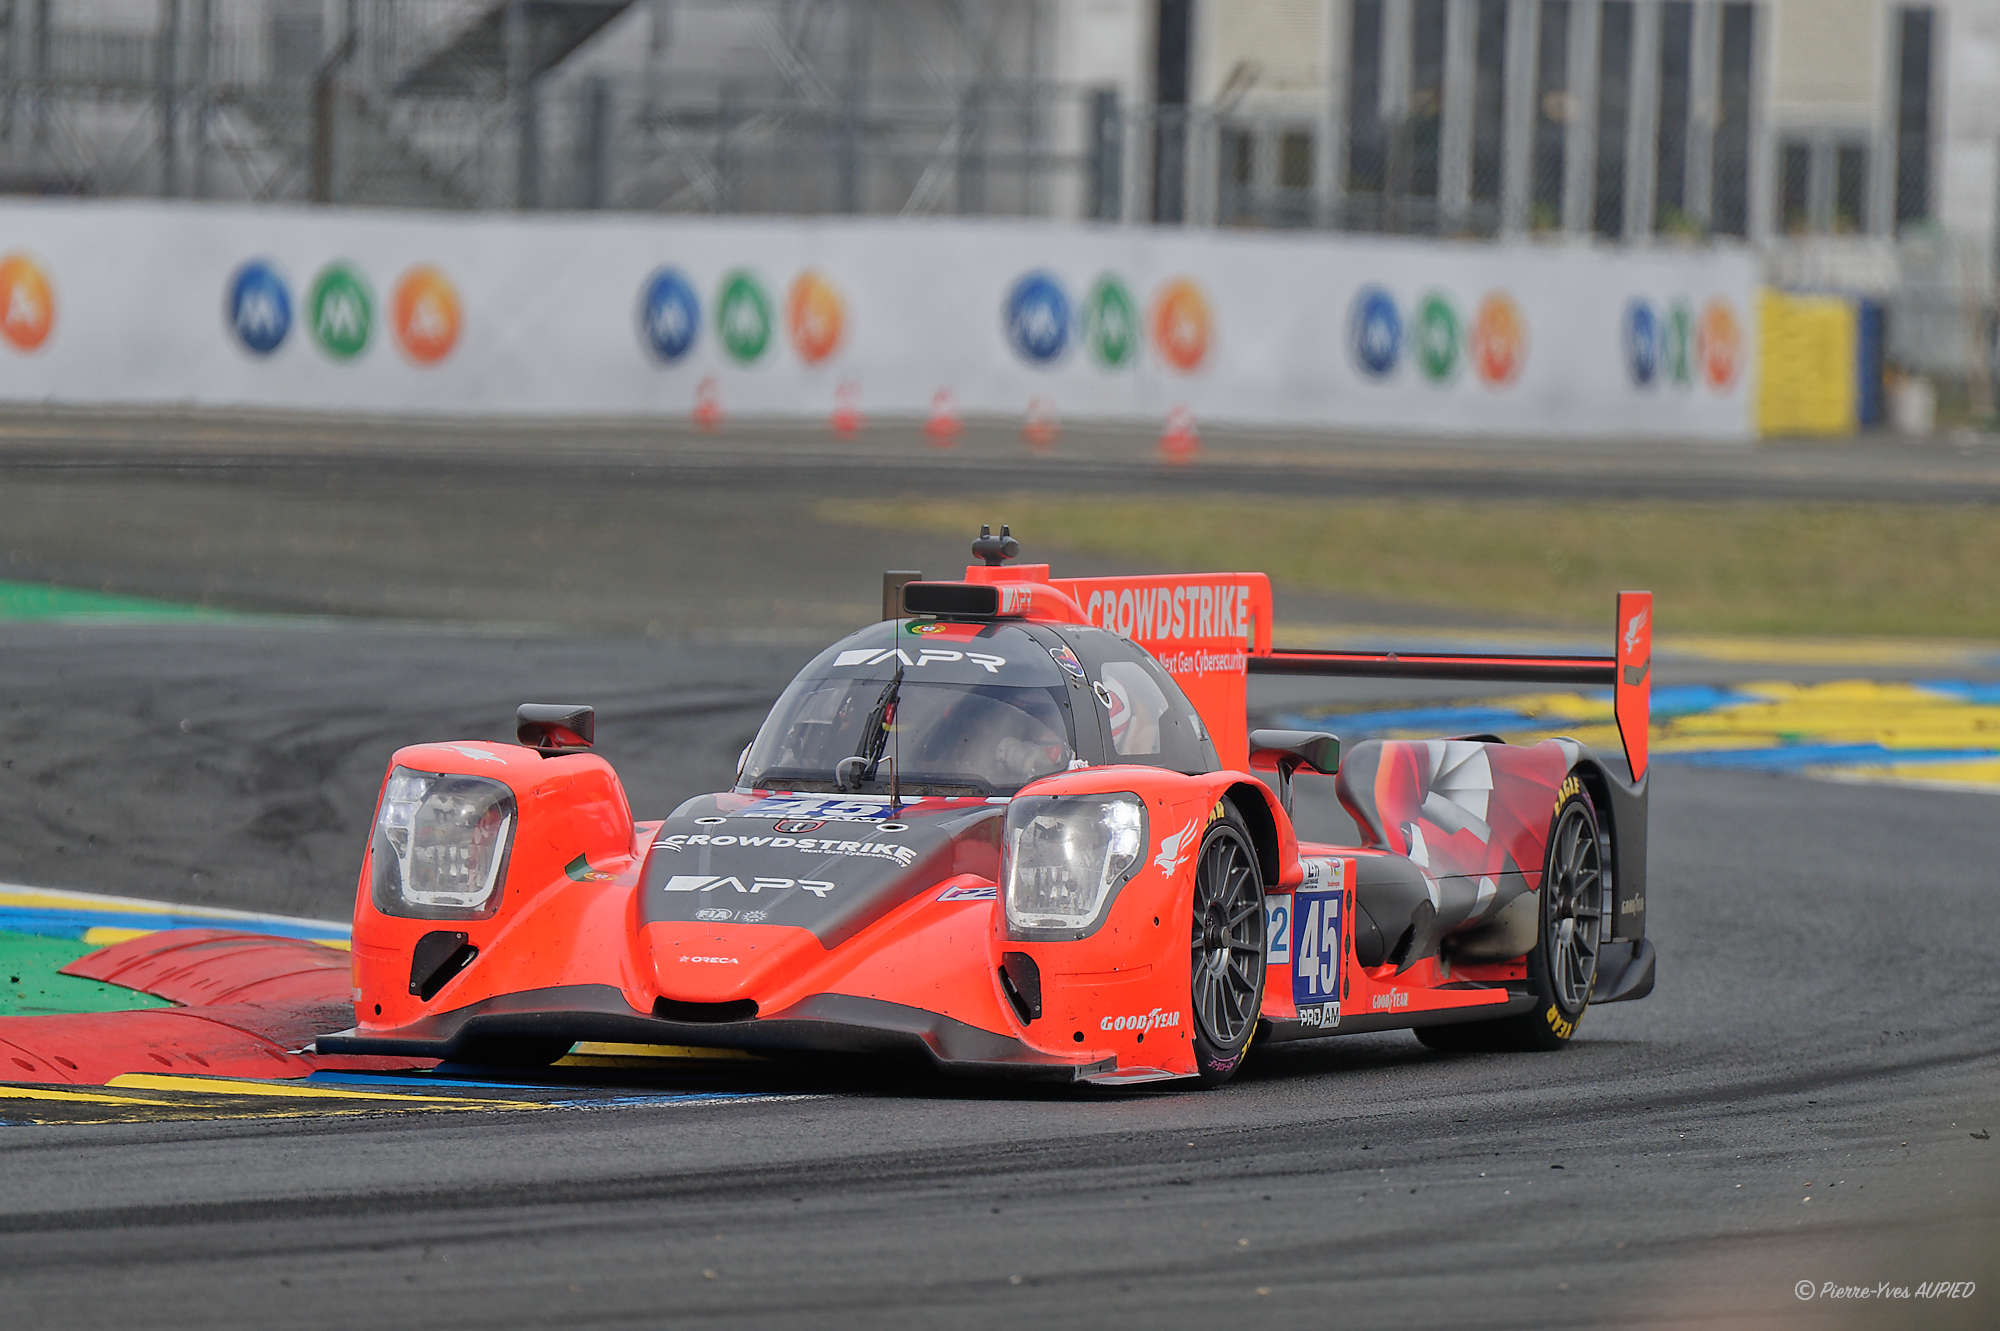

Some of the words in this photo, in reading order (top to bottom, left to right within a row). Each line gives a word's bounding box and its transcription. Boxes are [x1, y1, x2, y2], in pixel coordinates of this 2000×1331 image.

[1087, 584, 1249, 640] CROWDSTRIKE
[866, 648, 1007, 673] APR
[1178, 651, 1193, 673] Gen
[1194, 648, 1248, 678] Cybersecurity
[1554, 775, 1580, 817] EAGLE
[665, 834, 918, 865] CROWDSTRIKE
[701, 876, 835, 898] APR
[699, 909, 729, 920] FIA
[1298, 899, 1339, 995] 45
[690, 956, 738, 965] ORECA
[1372, 987, 1409, 1013] GOODYEAR
[1100, 1007, 1180, 1033] GOODYEAR
[1300, 1008, 1321, 1028] PRO
[1323, 1006, 1340, 1026] AM
